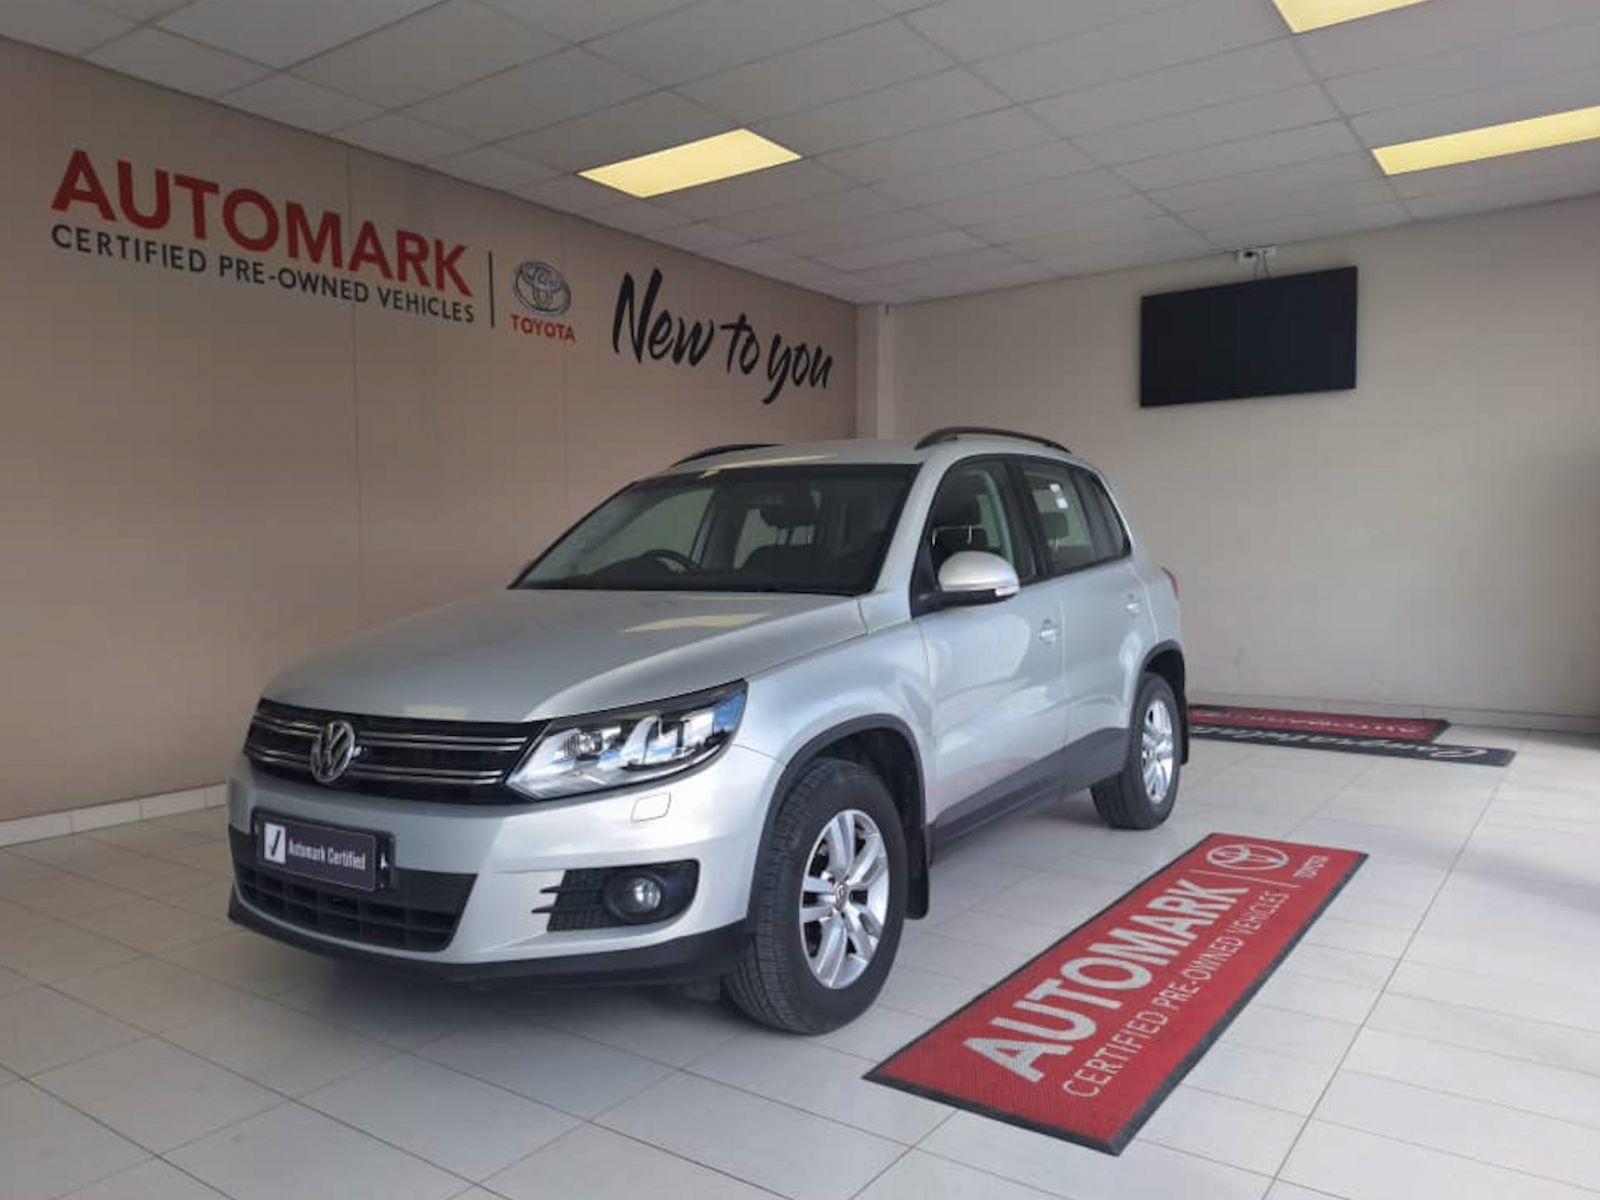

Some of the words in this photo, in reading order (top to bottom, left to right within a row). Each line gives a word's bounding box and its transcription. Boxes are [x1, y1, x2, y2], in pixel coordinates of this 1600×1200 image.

[51, 149, 473, 297] AUTOMARK
[51, 224, 206, 273] CERTIFIED
[218, 255, 369, 303] PRE-OWNED
[377, 286, 475, 324] VEHICLES
[511, 313, 576, 343] TOYOTA
[612, 268, 714, 364] New
[720, 313, 760, 375] to
[762, 334, 833, 405] you
[288, 838, 326, 863] Automark
[327, 846, 367, 872] Certified
[962, 878, 1249, 1083] AUTOMARK
[1062, 1009, 1169, 1098] CERTIFIED
[1151, 934, 1246, 1011] PRE-OWNED
[1226, 889, 1290, 936] VEHICLES
